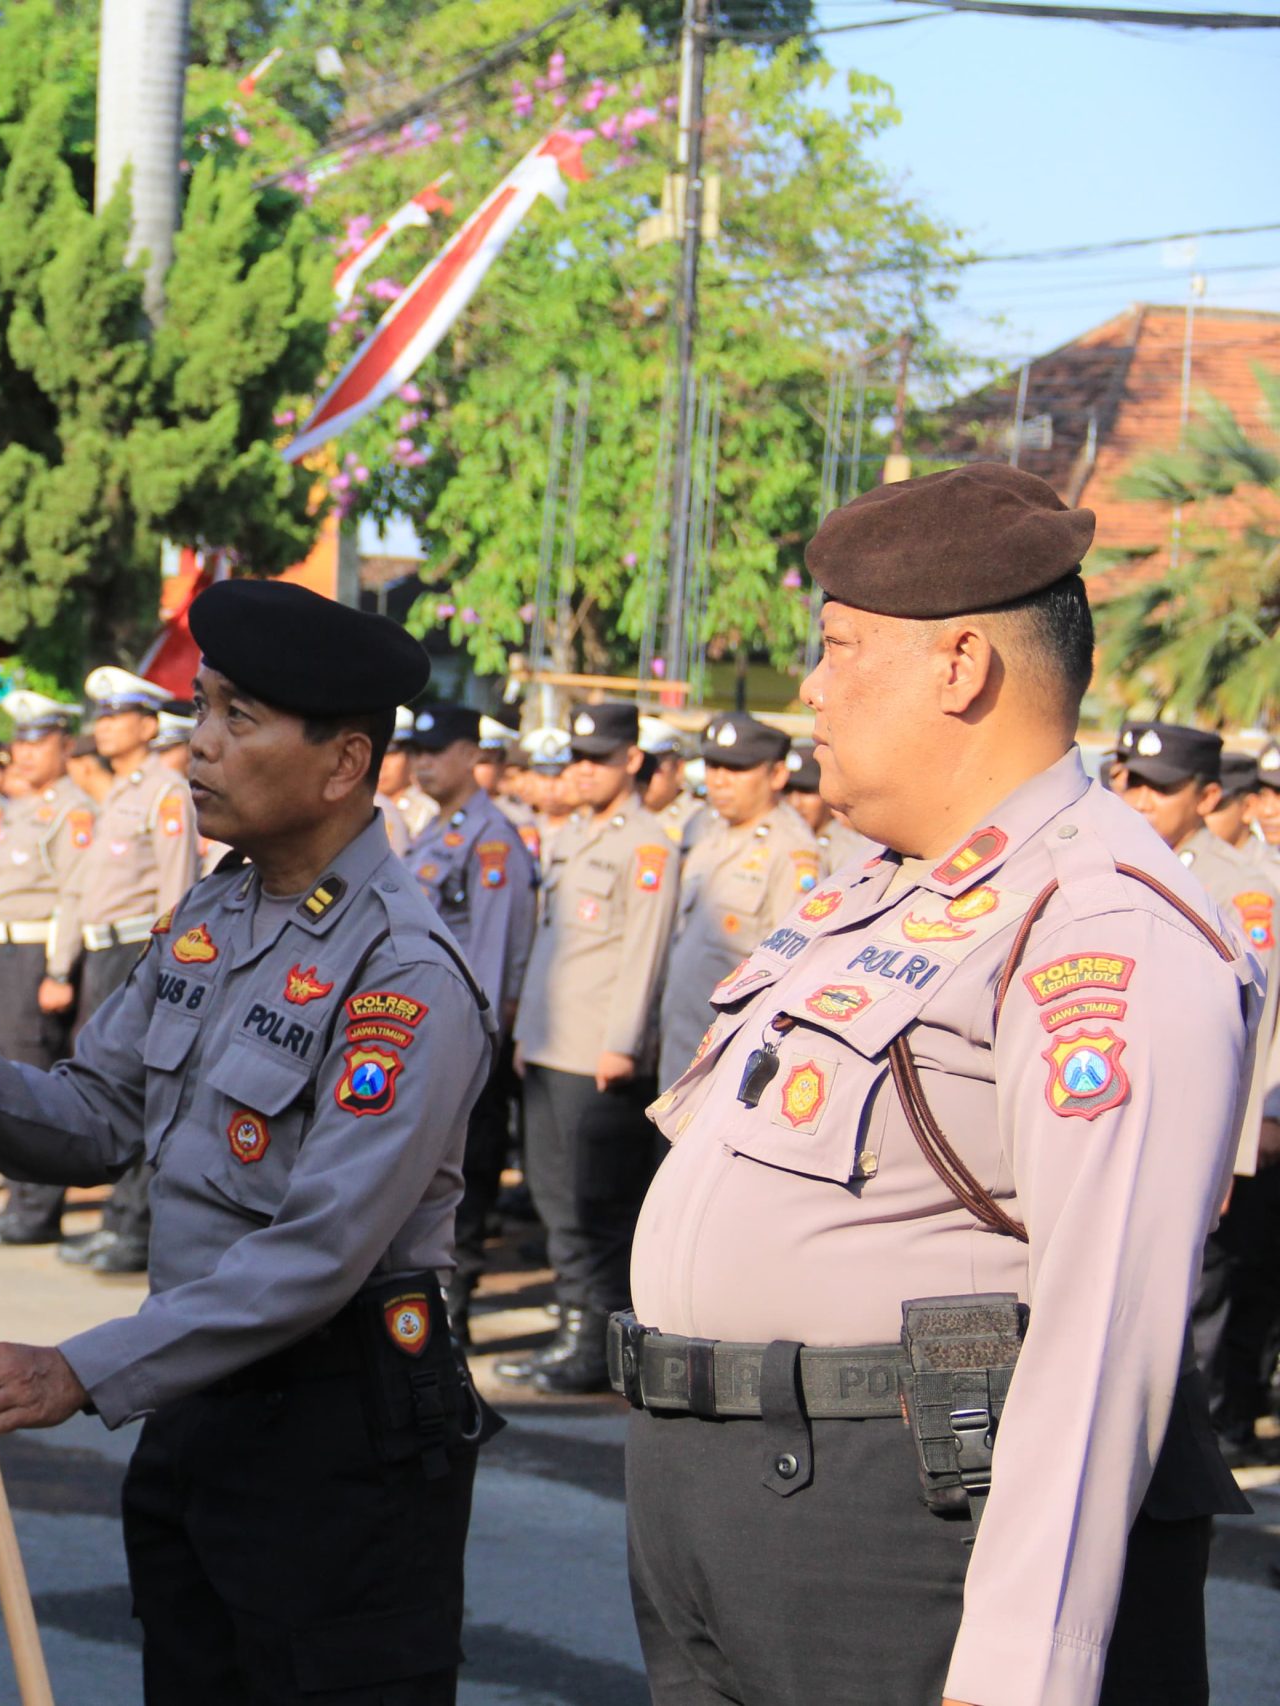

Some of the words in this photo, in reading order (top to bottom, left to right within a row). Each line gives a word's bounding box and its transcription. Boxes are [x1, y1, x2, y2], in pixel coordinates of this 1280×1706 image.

[847, 945, 941, 990] POLRI
[1032, 957, 1124, 992] POLRES
[1042, 973, 1080, 997] KEDIRI
[1084, 971, 1118, 984] KOTA
[185, 985, 206, 1010] B
[352, 995, 418, 1016] POLRES
[389, 1007, 412, 1021] KOTA
[1048, 1005, 1079, 1025] JAWA
[1082, 1002, 1118, 1014] TIMUR
[243, 1003, 314, 1058] POLRI
[351, 1026, 377, 1038] JAWA
[378, 1026, 407, 1043] TIMUR
